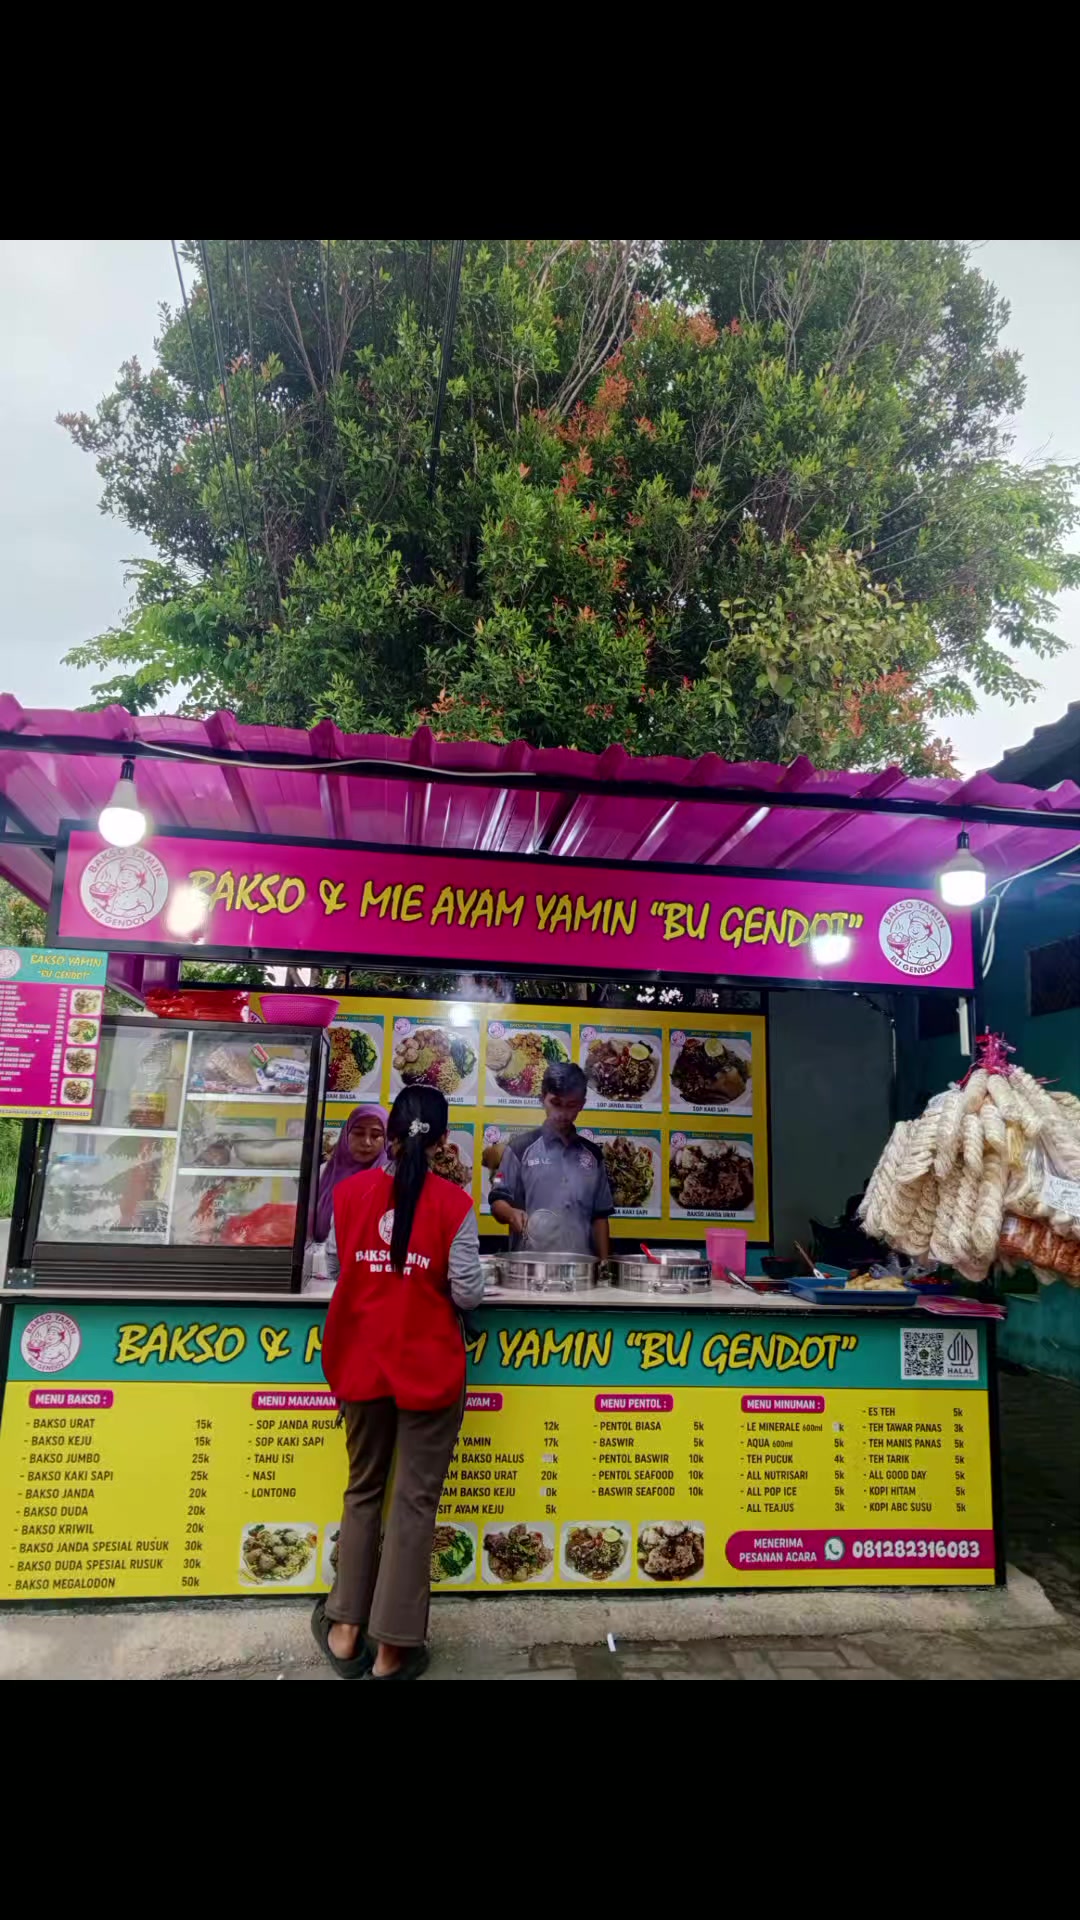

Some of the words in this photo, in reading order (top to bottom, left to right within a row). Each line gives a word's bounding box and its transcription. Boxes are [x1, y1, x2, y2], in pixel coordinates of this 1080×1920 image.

[188, 870, 306, 914] BAKSO
[319, 879, 347, 915] &
[360, 880, 425, 922] MIE
[430, 886, 525, 929] AYAM
[535, 894, 637, 936] YAMIN
[883, 902, 913, 925] BAKSO
[918, 902, 947, 929] YAMIN
[105, 916, 146, 927] GENDOT
[890, 955, 902, 967] BU
[902, 963, 937, 974] GENDOT
[370, 1264, 382, 1272] BU
[115, 1323, 247, 1364] BAKSO
[259, 1326, 291, 1363] &
[499, 1329, 612, 1369] YAMIN
[35, 1394, 64, 1405] MENU
[67, 1394, 101, 1405] BAKSO
[258, 1396, 285, 1406] MENU
[288, 1396, 336, 1407] MAKANAN
[600, 1399, 625, 1409] MENU
[628, 1399, 661, 1409] PENTOL
[747, 1400, 772, 1409] MENU
[774, 1400, 815, 1410] MINUMAN
[868, 1408, 879, 1416] ES
[881, 1407, 896, 1417] TEH
[953, 1408, 963, 1417] 5k
[33, 1419, 67, 1429] BAKSO
[70, 1418, 95, 1429] URAT
[195, 1419, 212, 1430] 15k
[256, 1420, 275, 1430] SOP
[278, 1420, 308, 1430] JANDA
[311, 1420, 343, 1430] RUSUK
[544, 1421, 560, 1431] 12k
[600, 1422, 632, 1431] PENTOL
[636, 1422, 662, 1431] BIASA
[747, 1423, 757, 1432] LE
[759, 1423, 800, 1432] MINERALE
[802, 1424, 823, 1432] 600ml
[868, 1423, 884, 1432] TEH
[886, 1423, 913, 1432] TAWAR
[915, 1423, 942, 1432] PANAS
[954, 1423, 964, 1433] 3k
[31, 1436, 65, 1447] BAKSO
[68, 1436, 92, 1447] KEJU
[194, 1436, 211, 1447] 15k
[255, 1436, 274, 1447] SOP
[277, 1436, 299, 1447] KAKI
[302, 1436, 324, 1447] SAPI
[463, 1437, 491, 1447] YAMIN
[544, 1438, 559, 1447] 17k
[599, 1438, 634, 1447] BASWIR
[693, 1438, 704, 1448] 5k
[747, 1439, 770, 1448] AQUA
[772, 1439, 793, 1448] 600ml
[869, 1439, 884, 1448] TEH
[886, 1439, 913, 1448] MANIS
[915, 1439, 942, 1448] PANAS
[954, 1439, 964, 1448] 5k
[29, 1453, 63, 1464] BAKSO
[66, 1453, 100, 1464] JUMBO
[192, 1453, 209, 1464] 25k
[254, 1454, 279, 1464] TAHU
[282, 1454, 294, 1464] ISI
[461, 1454, 492, 1464] BAKSO
[495, 1453, 525, 1464] HALUS
[599, 1454, 632, 1464] PENTOL
[635, 1454, 669, 1464] BASWIR
[688, 1454, 704, 1464] 10k
[747, 1455, 763, 1464] TEH
[765, 1455, 793, 1464] PUCUK
[834, 1454, 844, 1464] 4k
[869, 1455, 884, 1464] TEH
[886, 1455, 910, 1464] TARIK
[27, 1471, 61, 1482] BAKSO
[64, 1471, 88, 1481] KAKI
[91, 1471, 114, 1481] SAPI
[190, 1471, 208, 1481] 25k
[252, 1471, 276, 1481] NASI
[461, 1470, 492, 1480] BAKSO
[494, 1470, 518, 1480] URAT
[541, 1471, 558, 1481] 20k
[598, 1471, 632, 1480] PENTOL
[634, 1471, 674, 1480] SEAFOOD
[688, 1470, 704, 1480] 10k
[747, 1471, 762, 1480] ALL
[764, 1471, 808, 1480] NUTRISARI
[834, 1471, 845, 1480] 5k
[869, 1471, 884, 1480] ALL
[886, 1471, 909, 1480] GOOD
[911, 1471, 927, 1480] DAY
[25, 1489, 59, 1499] BAKSO
[62, 1488, 95, 1499] JANDA
[188, 1488, 207, 1499] 20k
[251, 1488, 297, 1498] LONTONG
[460, 1487, 491, 1497] BAKSO
[493, 1487, 516, 1497] KEJU
[598, 1487, 633, 1497] BASWIR
[635, 1487, 675, 1497] SEAFOOD
[688, 1487, 704, 1497] 10k
[747, 1487, 762, 1496] ALL
[764, 1487, 781, 1496] POP
[784, 1487, 797, 1496] ICE
[834, 1487, 845, 1496] 5k
[869, 1487, 888, 1496] KOPI
[890, 1487, 916, 1496] HITAM
[23, 1506, 57, 1517] BAKSO
[61, 1506, 88, 1517] DUDA
[187, 1505, 206, 1516] 20k
[455, 1504, 479, 1514] AYAM
[482, 1504, 504, 1514] KEJU
[545, 1505, 557, 1514] 5k
[747, 1503, 762, 1512] ALL
[764, 1503, 794, 1512] TEAJUS
[834, 1503, 845, 1512] 3k
[869, 1503, 888, 1512] KOPI
[891, 1503, 908, 1512] ABC
[910, 1503, 932, 1512] SUSU
[21, 1525, 56, 1535] BAKSO
[58, 1524, 94, 1535] KRIWIL
[186, 1523, 204, 1534] 20k
[19, 1543, 53, 1553] BAKSO
[56, 1542, 89, 1553] JANDA
[93, 1542, 133, 1552] SPESIAL
[136, 1541, 169, 1551] RUSUK
[184, 1541, 203, 1551] 30k
[753, 1538, 803, 1548] MENERIMA
[852, 1540, 980, 1559] 081282316083
[739, 1552, 783, 1563] PESANAN
[785, 1552, 817, 1562] ACARA
[17, 1561, 52, 1572] BAKSO
[55, 1560, 83, 1571] DUDA
[86, 1559, 127, 1570] SPESIAL
[129, 1559, 164, 1569] RUSUK
[183, 1558, 201, 1569] 30k
[15, 1579, 49, 1590] BAKSO
[52, 1578, 116, 1589] MEGALODON
[181, 1576, 200, 1587] 50k
